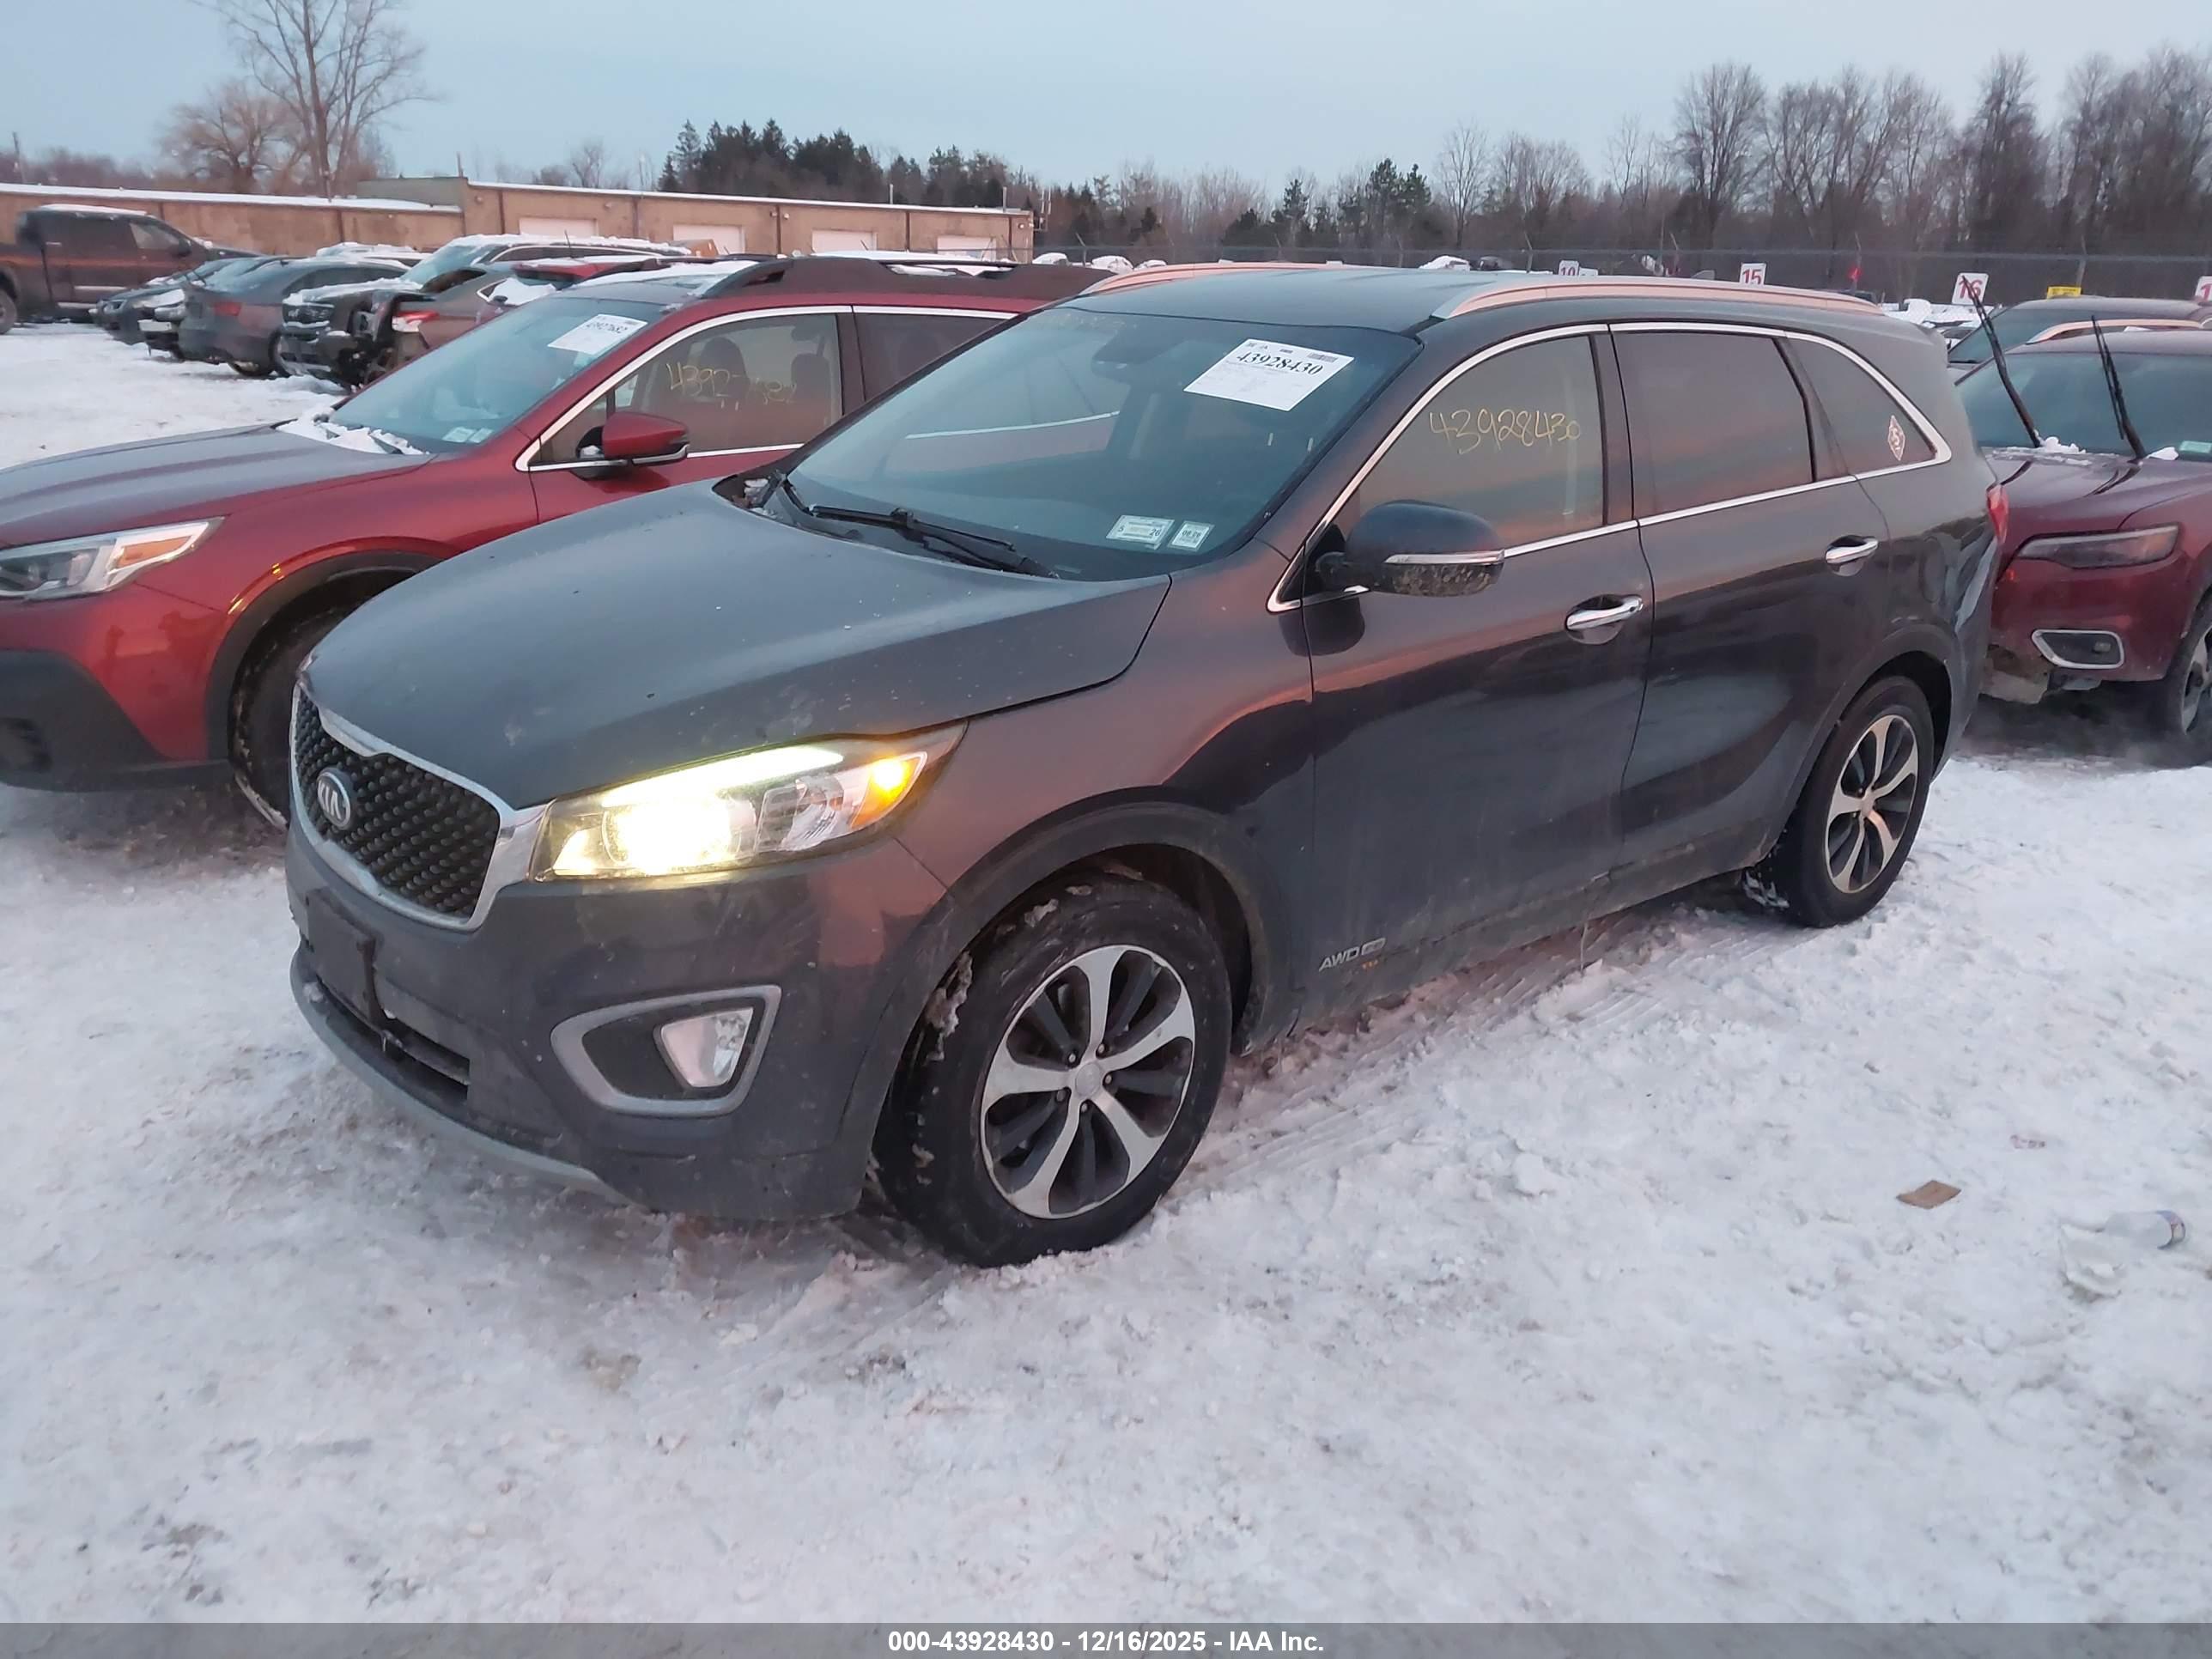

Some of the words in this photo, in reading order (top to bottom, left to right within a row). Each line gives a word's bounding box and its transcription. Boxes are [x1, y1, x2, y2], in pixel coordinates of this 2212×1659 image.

[1742, 269, 1762, 284] 15
[1959, 279, 1983, 299] 16
[1237, 351, 1324, 375] 43928430
[1429, 408, 1581, 455] 43928430
[1149, 526, 1163, 538] 26
[317, 779, 343, 821] KIA
[1318, 946, 1360, 973] AWD
